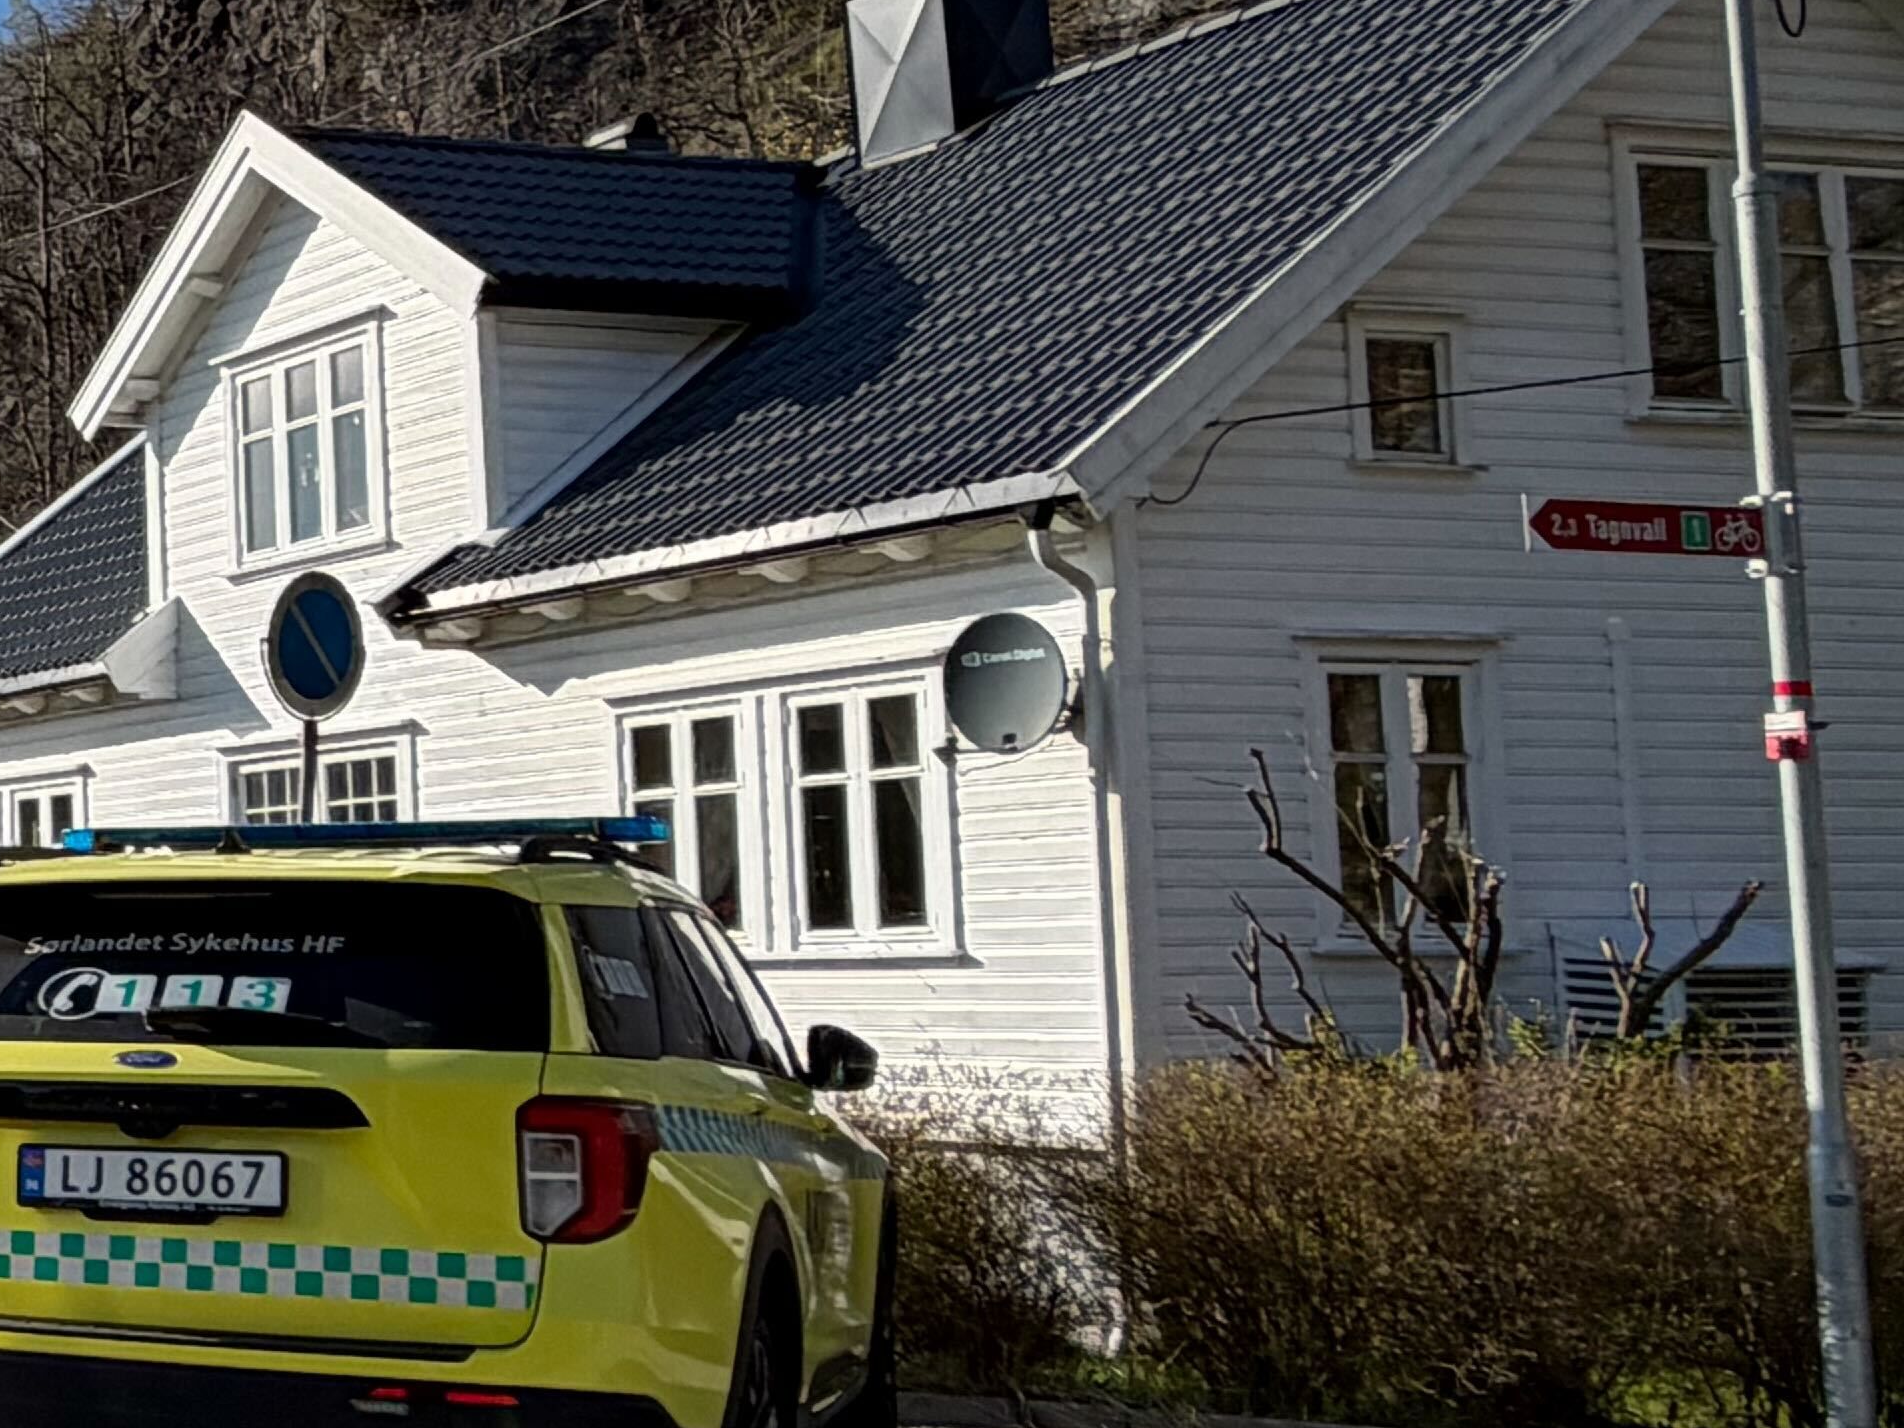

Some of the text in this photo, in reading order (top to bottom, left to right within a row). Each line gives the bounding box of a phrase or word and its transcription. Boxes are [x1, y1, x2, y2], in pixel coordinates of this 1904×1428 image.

[168, 932, 295, 955] Sykehus
[301, 934, 346, 954] HF
[61, 1155, 265, 1200] LJ 86067
